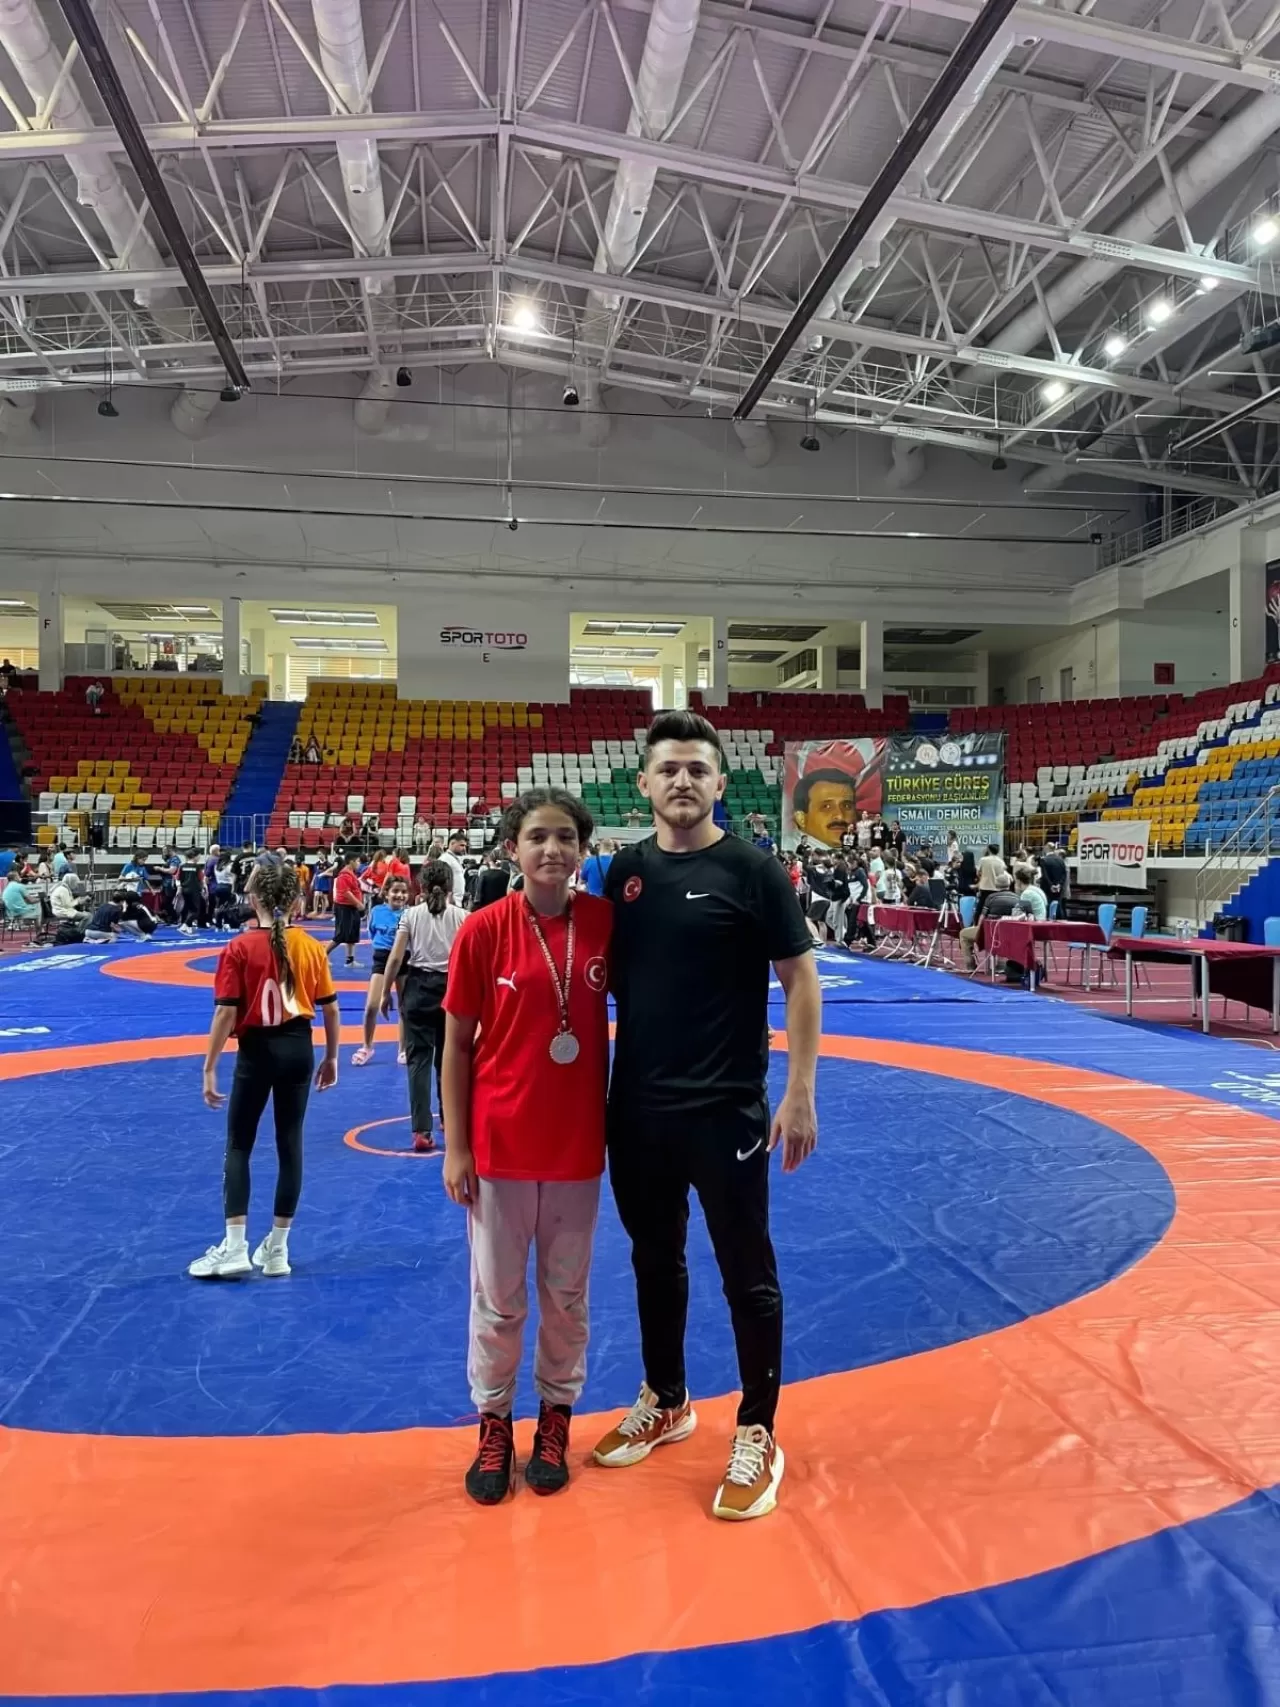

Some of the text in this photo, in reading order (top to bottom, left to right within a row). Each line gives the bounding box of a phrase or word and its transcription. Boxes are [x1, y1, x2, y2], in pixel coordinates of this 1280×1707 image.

[44, 618, 52, 629] F
[482, 652, 490, 663] E
[886, 774, 990, 792] TÜRKİYE GÜREŞ
[887, 793, 940, 803] FEDERASYONU
[898, 805, 981, 822] İSMAİL DEMİRCİ
